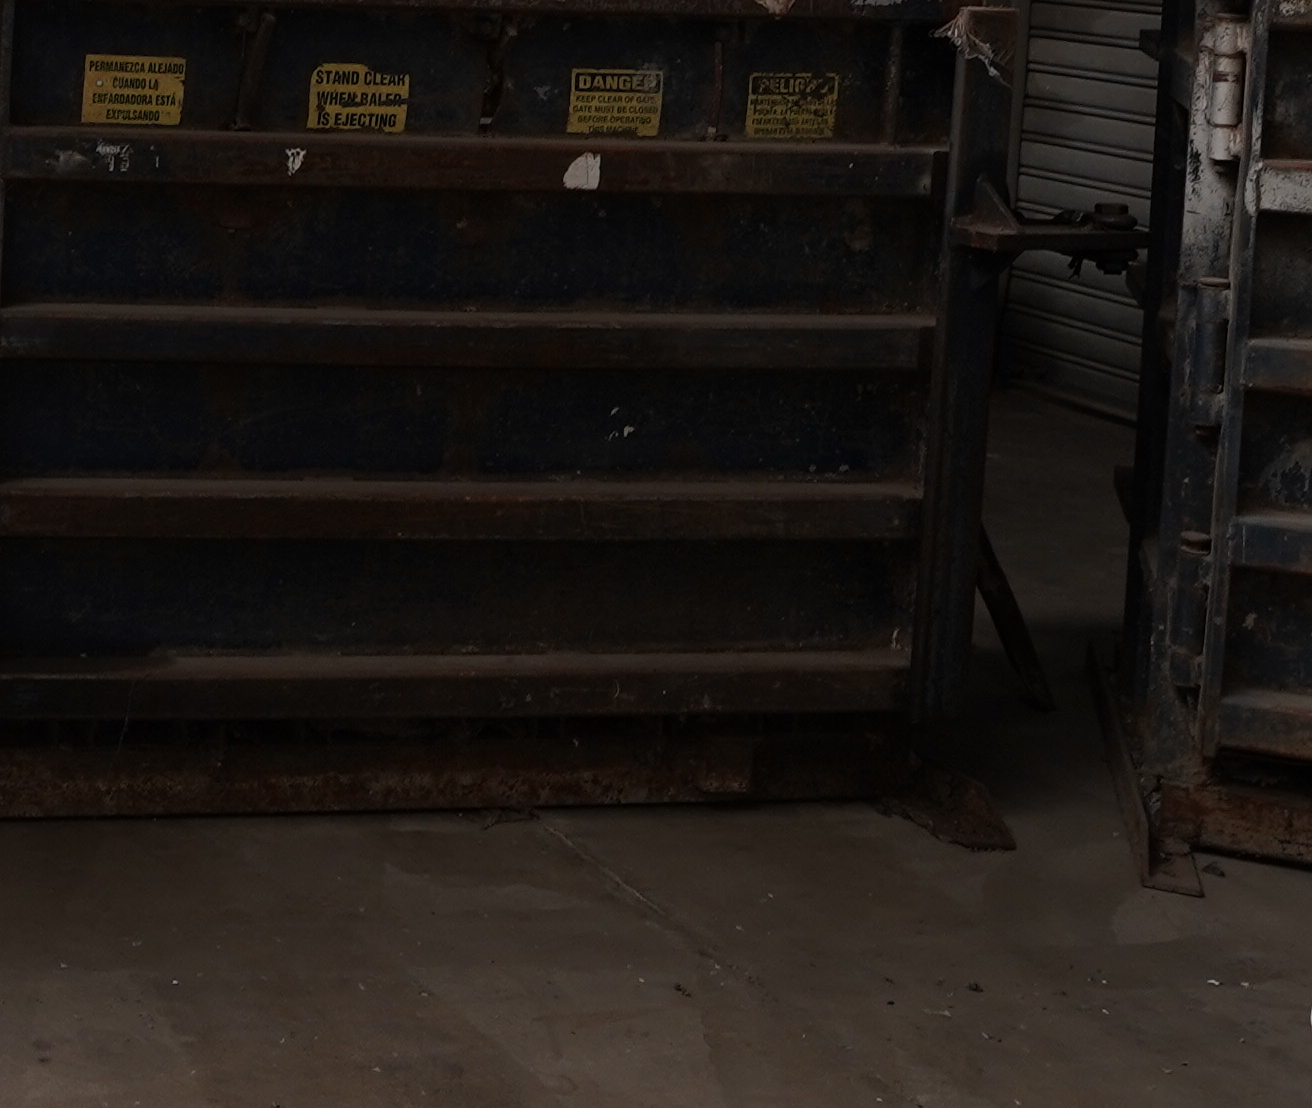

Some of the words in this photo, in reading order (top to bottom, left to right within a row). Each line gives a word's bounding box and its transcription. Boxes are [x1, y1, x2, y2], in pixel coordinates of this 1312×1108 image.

[89, 61, 145, 73] PERMANEZCA
[148, 62, 184, 74] ALEJADO
[113, 77, 146, 89] CUANDO
[316, 70, 359, 85] STAND
[364, 71, 405, 86] CLEAR
[93, 93, 153, 106] ENFARDADORA
[156, 92, 175, 106] ESTÁ
[317, 91, 356, 106] WHEN
[361, 93, 402, 107] BALER
[598, 95, 622, 103] CLEAR
[106, 109, 160, 121] EXPULSANDO
[317, 112, 329, 125] IS
[334, 113, 396, 128] EJECTING
